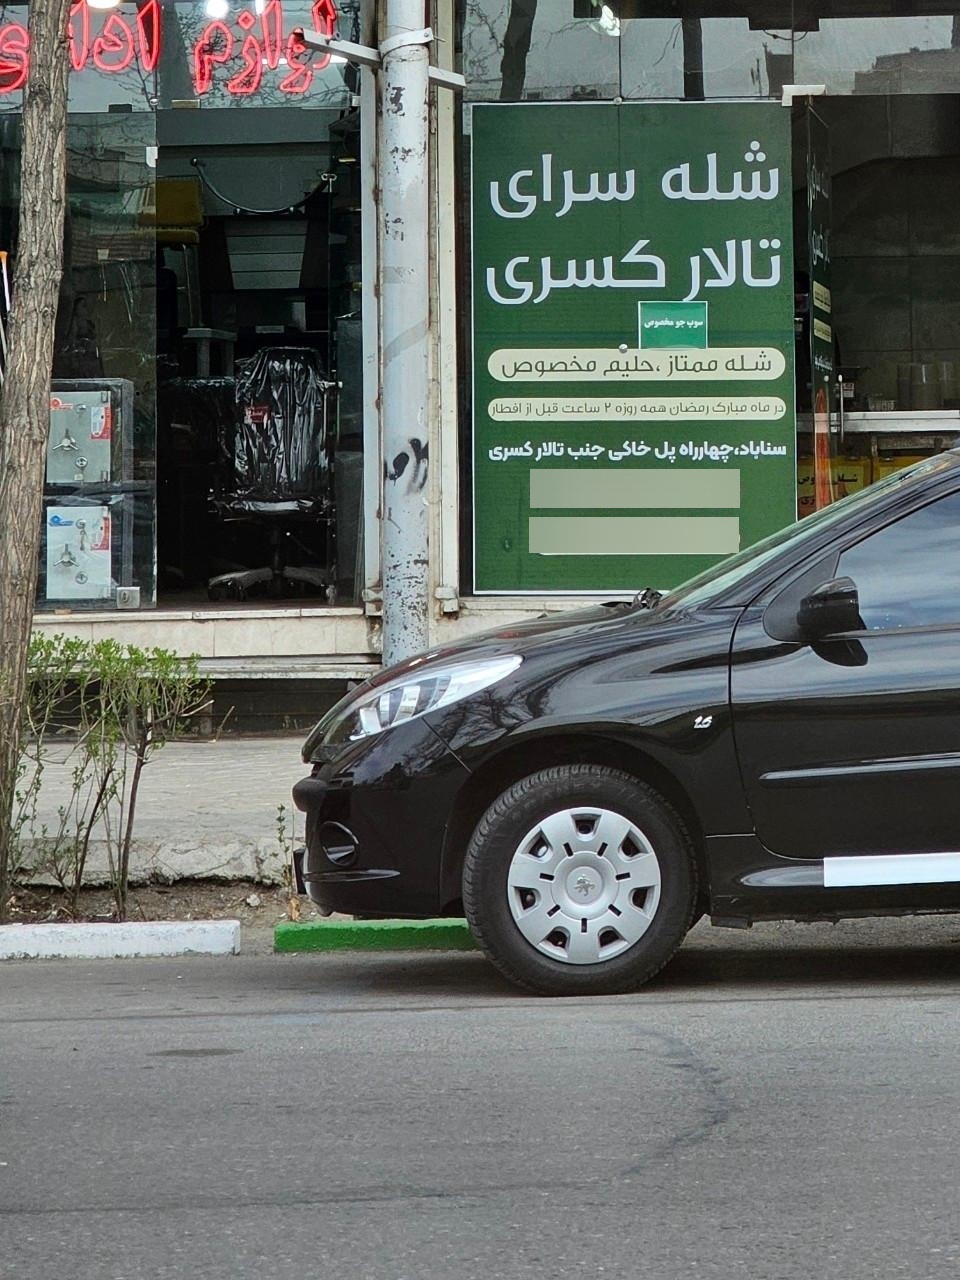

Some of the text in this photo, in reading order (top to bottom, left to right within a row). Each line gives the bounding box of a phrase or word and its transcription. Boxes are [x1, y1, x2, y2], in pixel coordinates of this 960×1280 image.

[661, 140, 779, 201] شله
[489, 153, 635, 219] سرای
[486, 239, 667, 306] کسری
[682, 238, 782, 303] تالار
[643, 317, 675, 329] مخصوص
[501, 355, 597, 379] مخصوص
[667, 355, 718, 377] ممتاز
[725, 351, 772, 372] شله
[491, 403, 522, 417] افطار
[524, 403, 532, 417] از
[535, 402, 559, 417] قبل
[561, 402, 600, 414] ساعت
[615, 403, 638, 417] روزه
[640, 403, 667, 415] همه
[669, 402, 710, 417] رمضان
[711, 402, 748, 417] مبارک
[750, 402, 770, 414] ماه
[773, 404, 785, 417] در
[488, 440, 534, 462] کسری
[534, 441, 564, 461] تالار
[567, 442, 606, 461] جنب
[608, 440, 652, 461] خاکی
[654, 441, 676, 464] پل
